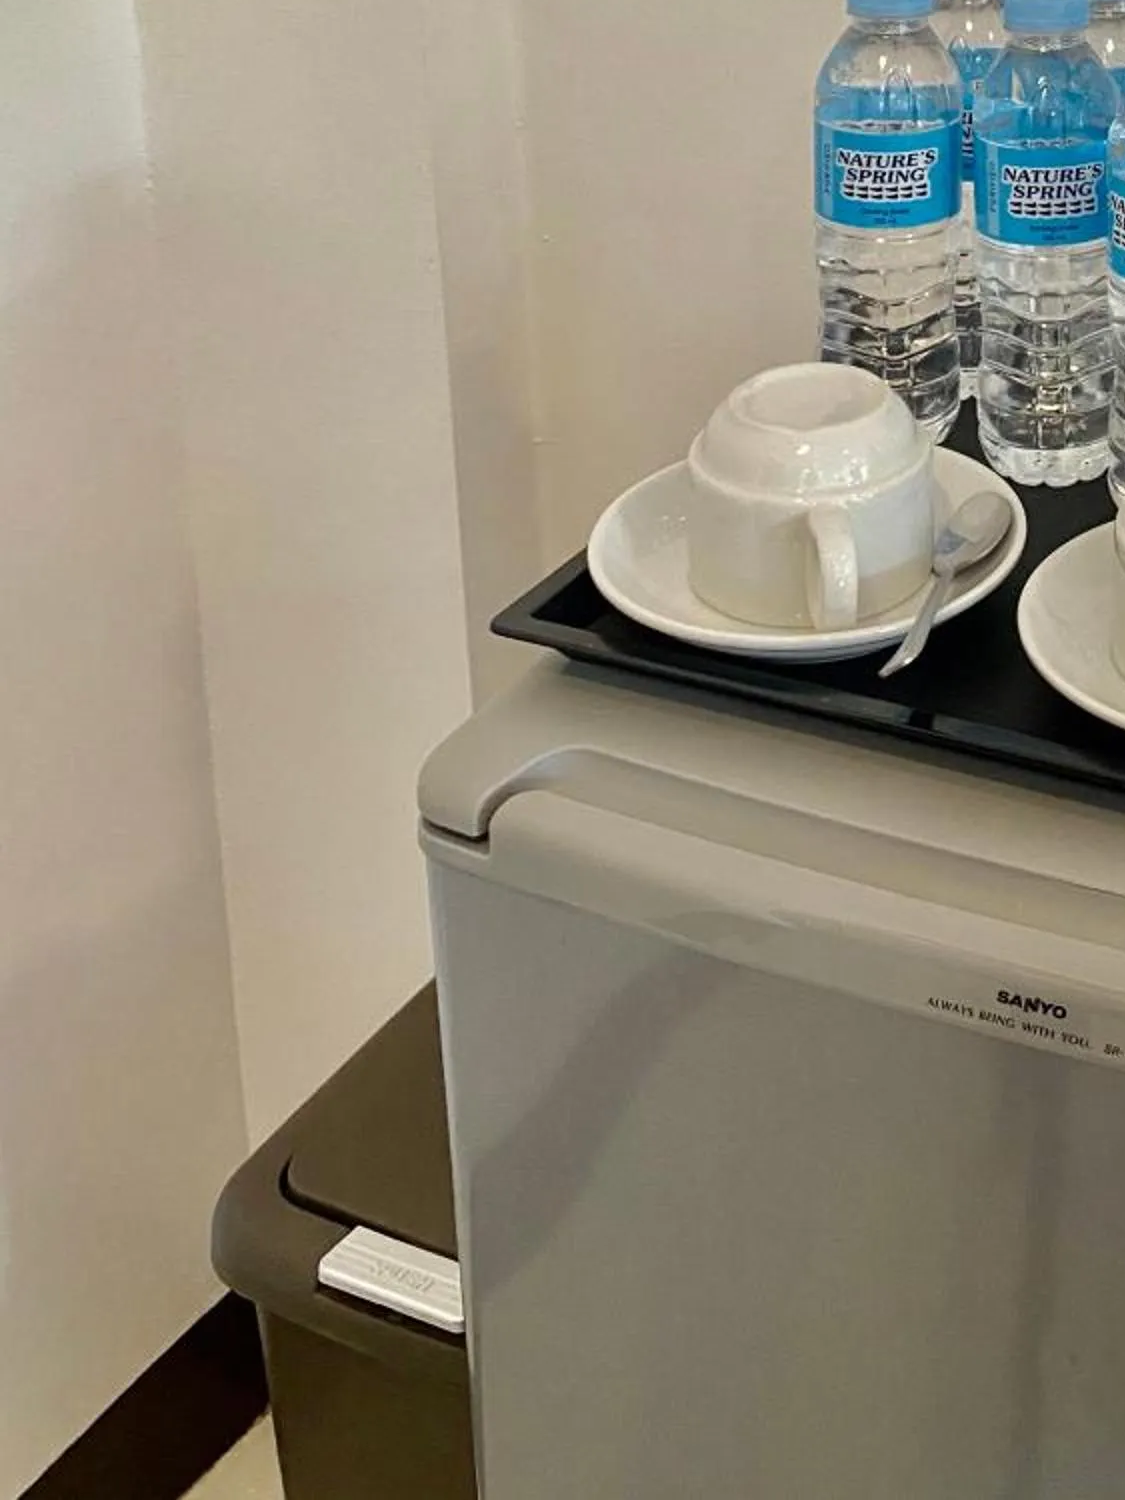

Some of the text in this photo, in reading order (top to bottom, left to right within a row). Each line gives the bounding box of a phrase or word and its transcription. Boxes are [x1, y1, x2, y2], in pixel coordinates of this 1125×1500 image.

[837, 149, 936, 168] NATURE'S
[845, 167, 926, 184] SPRING
[1003, 164, 1102, 182] NATURE'S
[1012, 182, 1094, 200] SPRING
[996, 990, 1067, 1019] SANYO
[928, 998, 974, 1018] ALWAYS
[1021, 1021, 1055, 1040] WITH
